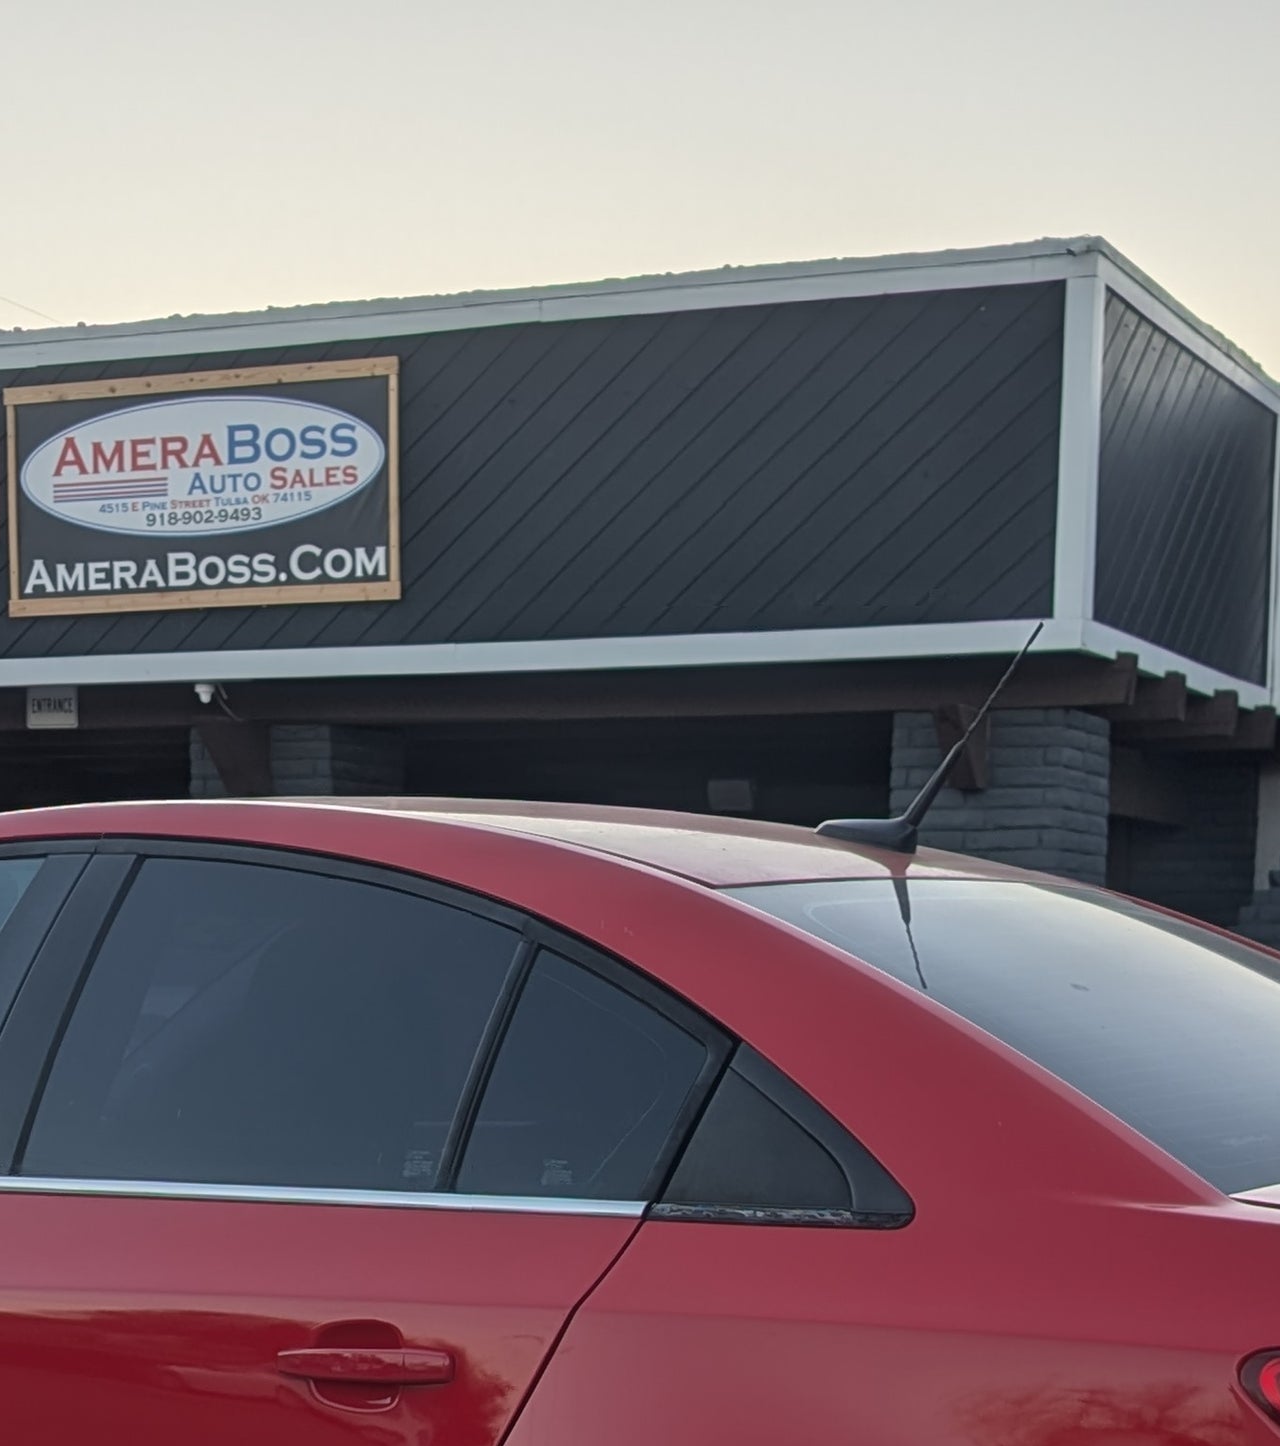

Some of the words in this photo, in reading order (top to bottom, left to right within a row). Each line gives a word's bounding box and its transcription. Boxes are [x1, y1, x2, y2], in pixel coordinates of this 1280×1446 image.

[187, 471, 262, 496] AUTO
[269, 464, 359, 491] SALES
[98, 502, 129, 514] 4515
[130, 501, 140, 512] E
[251, 494, 270, 505] OK
[272, 490, 313, 504] 74115
[145, 506, 263, 528] 918-902-9493
[32, 697, 73, 714] ENTRANCE
